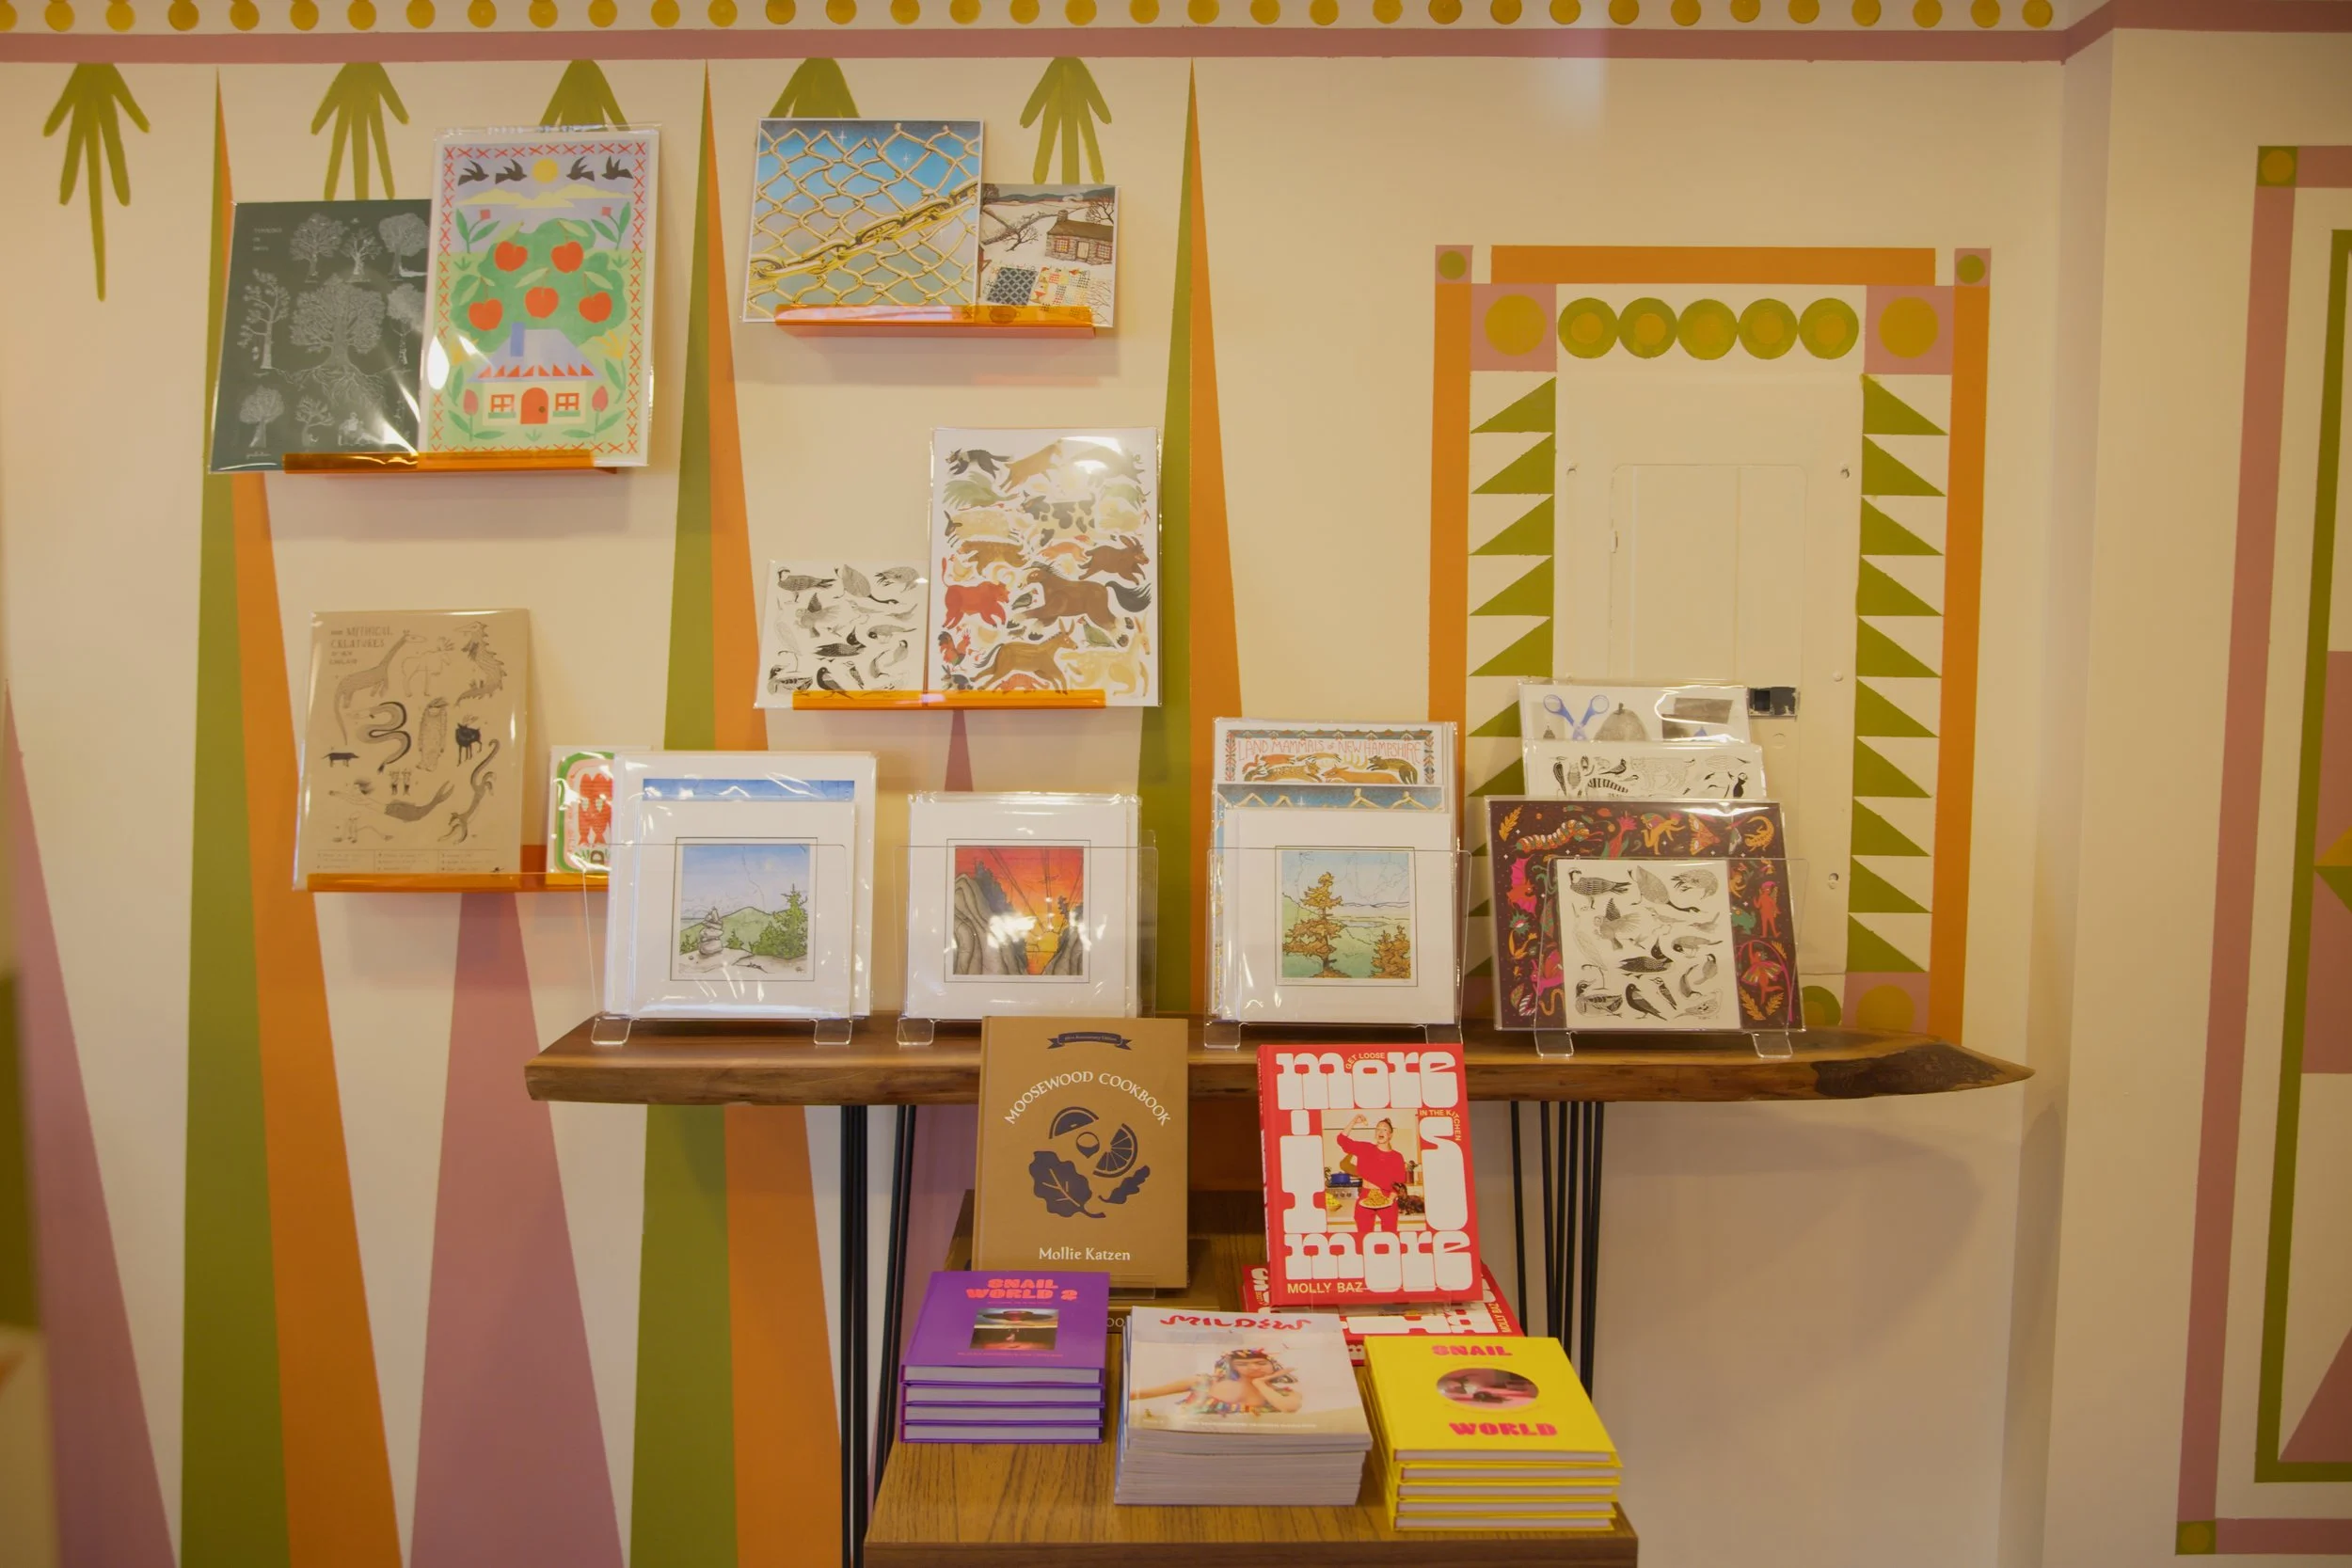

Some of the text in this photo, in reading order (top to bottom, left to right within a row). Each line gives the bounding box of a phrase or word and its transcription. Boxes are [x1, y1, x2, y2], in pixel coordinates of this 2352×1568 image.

[1237, 739, 1268, 761] LAND
[1271, 739, 1325, 753] MAMMALS
[1337, 740, 1362, 753] NEW
[1363, 740, 1422, 765] HAMPSHIRE
[1345, 1052, 1386, 1069] GET LOOSE
[1276, 1052, 1458, 1110] more
[1004, 1070, 1171, 1126] MOOSEWOOD COOKBOOK
[1446, 1110, 1462, 1142] KITCHEN
[1039, 1246, 1131, 1260] Mollie Katzen
[1284, 1230, 1473, 1293] more
[988, 1278, 1058, 1289] SNAIL
[1287, 1282, 1364, 1294] MOLLY BAZ
[965, 1288, 1078, 1301] WORLD 2
[1160, 1315, 1311, 1331] MILDEW
[1431, 1345, 1513, 1356] SNAIL
[1449, 1421, 1558, 1436] WORLD
